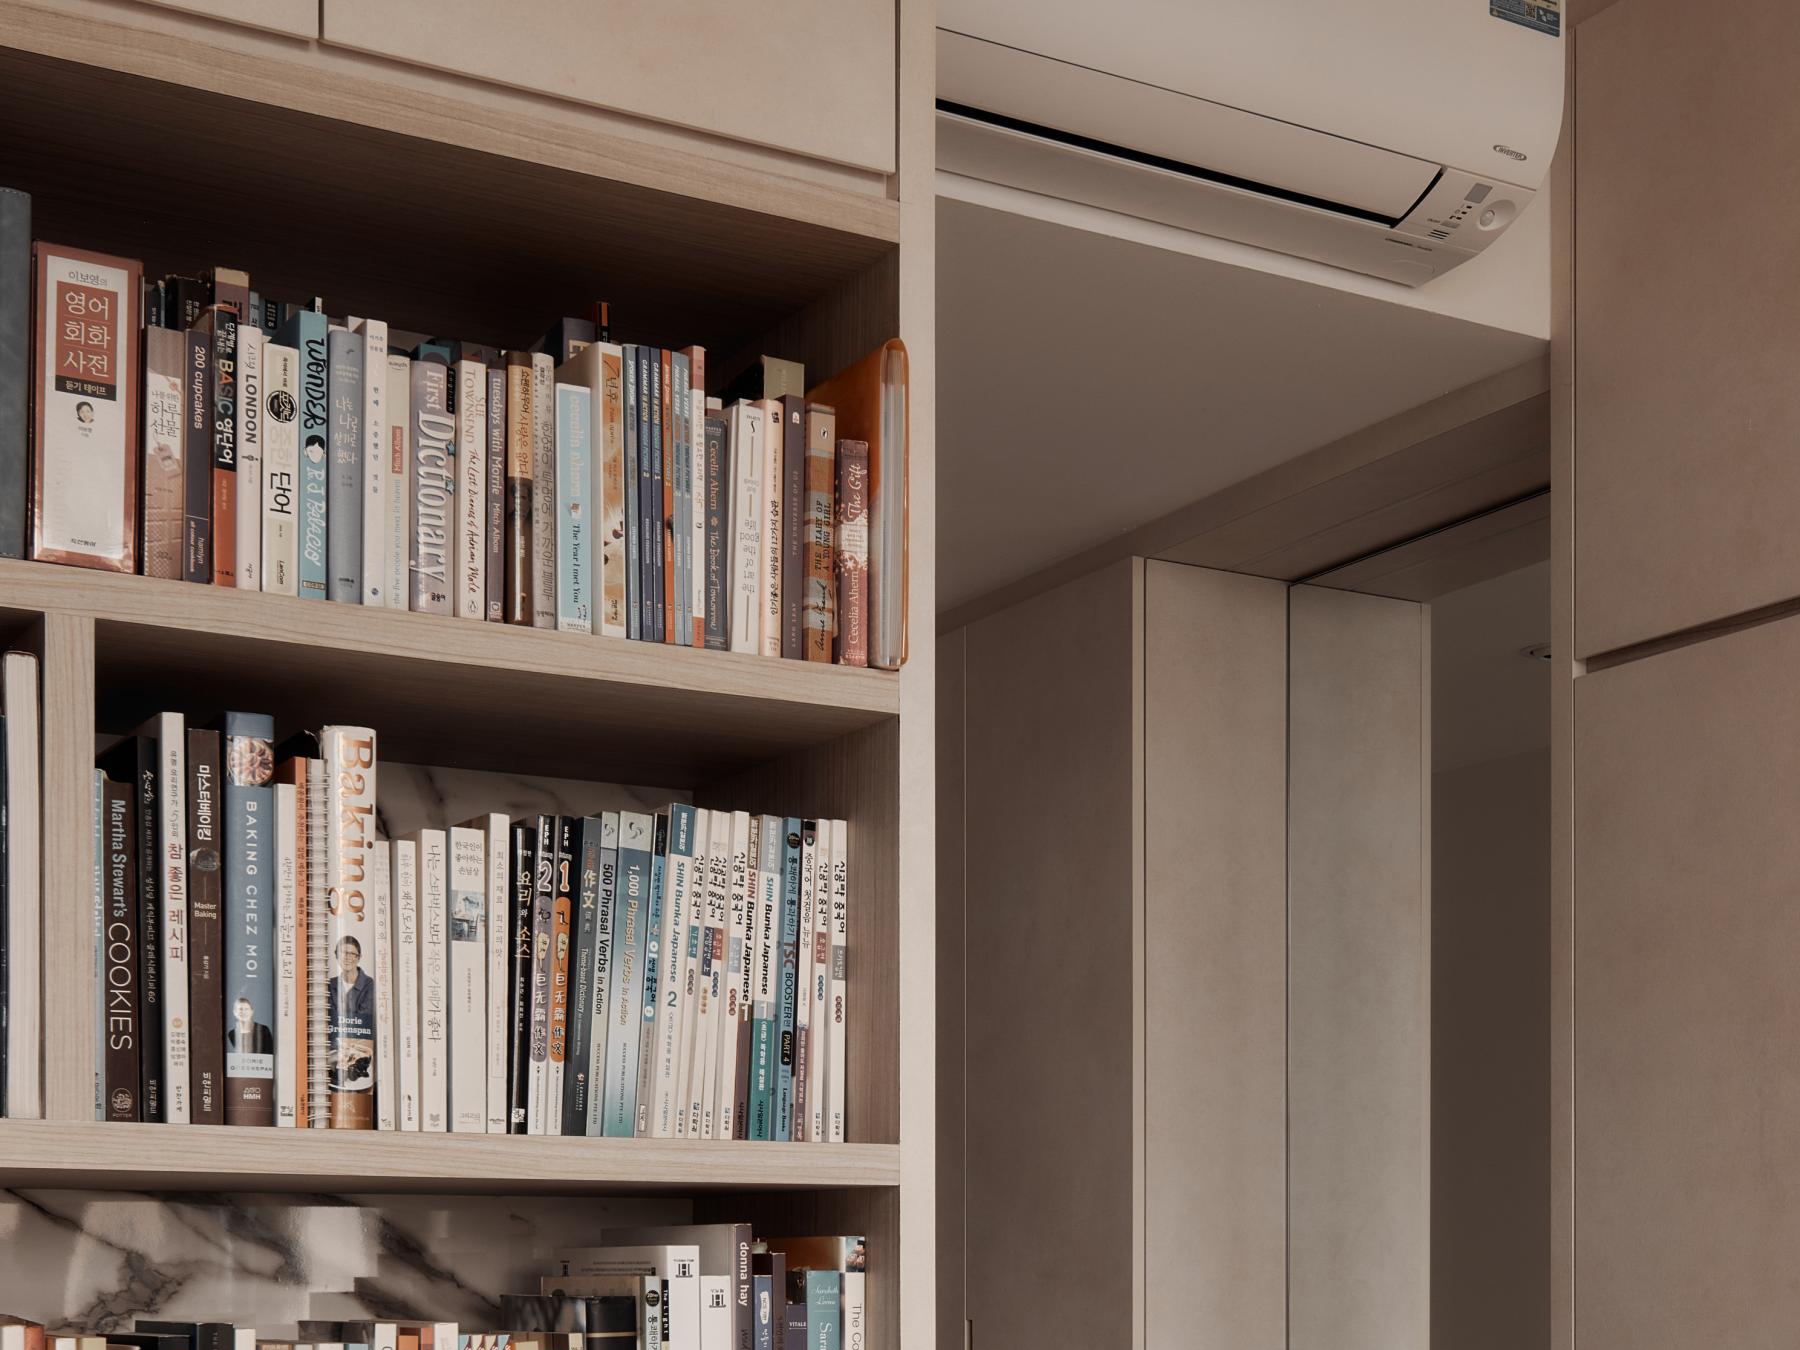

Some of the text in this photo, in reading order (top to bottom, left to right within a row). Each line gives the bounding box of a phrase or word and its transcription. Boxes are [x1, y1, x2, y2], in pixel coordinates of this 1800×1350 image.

[65, 292, 109, 320] 영어
[64, 321, 111, 349] 회화
[63, 350, 109, 378] 사전
[192, 346, 206, 429] 200 cupcakes
[303, 338, 327, 429] WONDER
[425, 370, 444, 409] First
[216, 359, 234, 464] BASIC 영단어
[244, 374, 257, 444] LONDON
[464, 368, 477, 444] TOWNSEND
[270, 472, 292, 514] 단어
[491, 378, 503, 553] tuesdays with Morrie Mitch Albom
[410, 410, 455, 583] Dictionary
[822, 502, 831, 527] GIRL
[572, 524, 581, 561] The Year
[709, 440, 719, 630] Cecelia Ahern The Book Tomorrow
[814, 517, 823, 571] THE DIARY
[468, 566, 480, 593] Mole
[848, 570, 860, 645] Cecelia Ahern
[197, 764, 212, 841] 마스터베이킹
[328, 735, 374, 922] Baking
[246, 801, 258, 978] BAKING CHEZ MOI
[537, 860, 552, 892] 2
[559, 861, 570, 893] 1
[676, 861, 685, 888] SHIN
[731, 852, 746, 926] 신공략 중국어
[817, 862, 829, 926] 신공략 중국어
[833, 860, 846, 933] 신공략 중국어
[109, 800, 133, 1050] Martha Stewart's COOKIES
[194, 902, 217, 910] Master
[194, 910, 217, 920] Baking
[622, 864, 640, 984] 1,000 Phrasal Verbs
[673, 889, 683, 927] Bunka
[169, 909, 184, 962] 레시피
[595, 863, 614, 1015] 500 Phrasal Verbs Action
[670, 927, 681, 983] Japanese
[741, 869, 757, 1002] SHIN Bunka Japanese
[760, 876, 775, 996] SHIN Bunka Japanese
[783, 940, 796, 969] TSC
[338, 1016, 363, 1025] Dorie
[667, 991, 677, 1008] 2
[427, 1016, 441, 1043] 좋다
[782, 1033, 792, 1055] PART
[738, 1241, 750, 1307] donna hay
[851, 1303, 862, 1328] The
